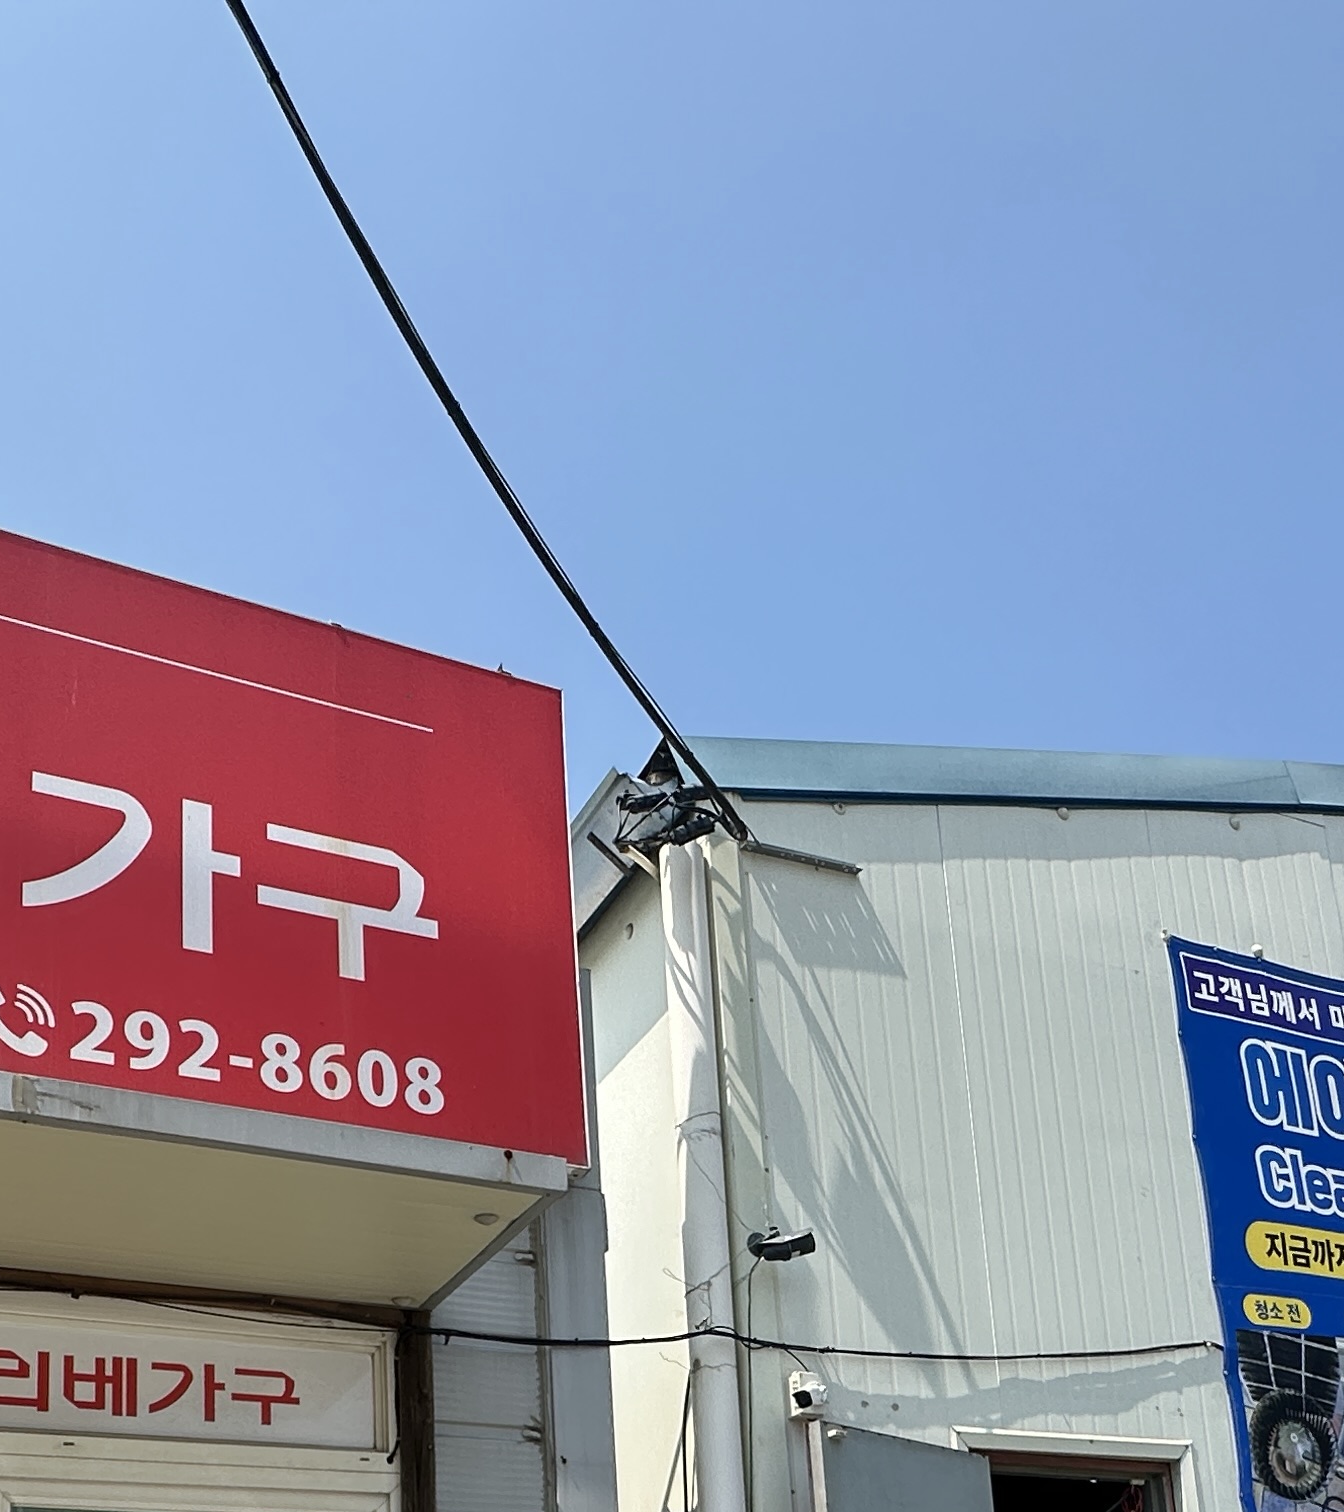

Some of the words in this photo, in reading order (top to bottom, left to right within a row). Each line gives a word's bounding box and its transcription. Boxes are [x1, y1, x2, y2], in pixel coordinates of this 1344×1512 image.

[1193, 970, 1322, 1030] 고객님께서
[70, 1000, 444, 1116] 292-8608
[1254, 1298, 1283, 1322] 청소
[1285, 1301, 1301, 1323] 전
